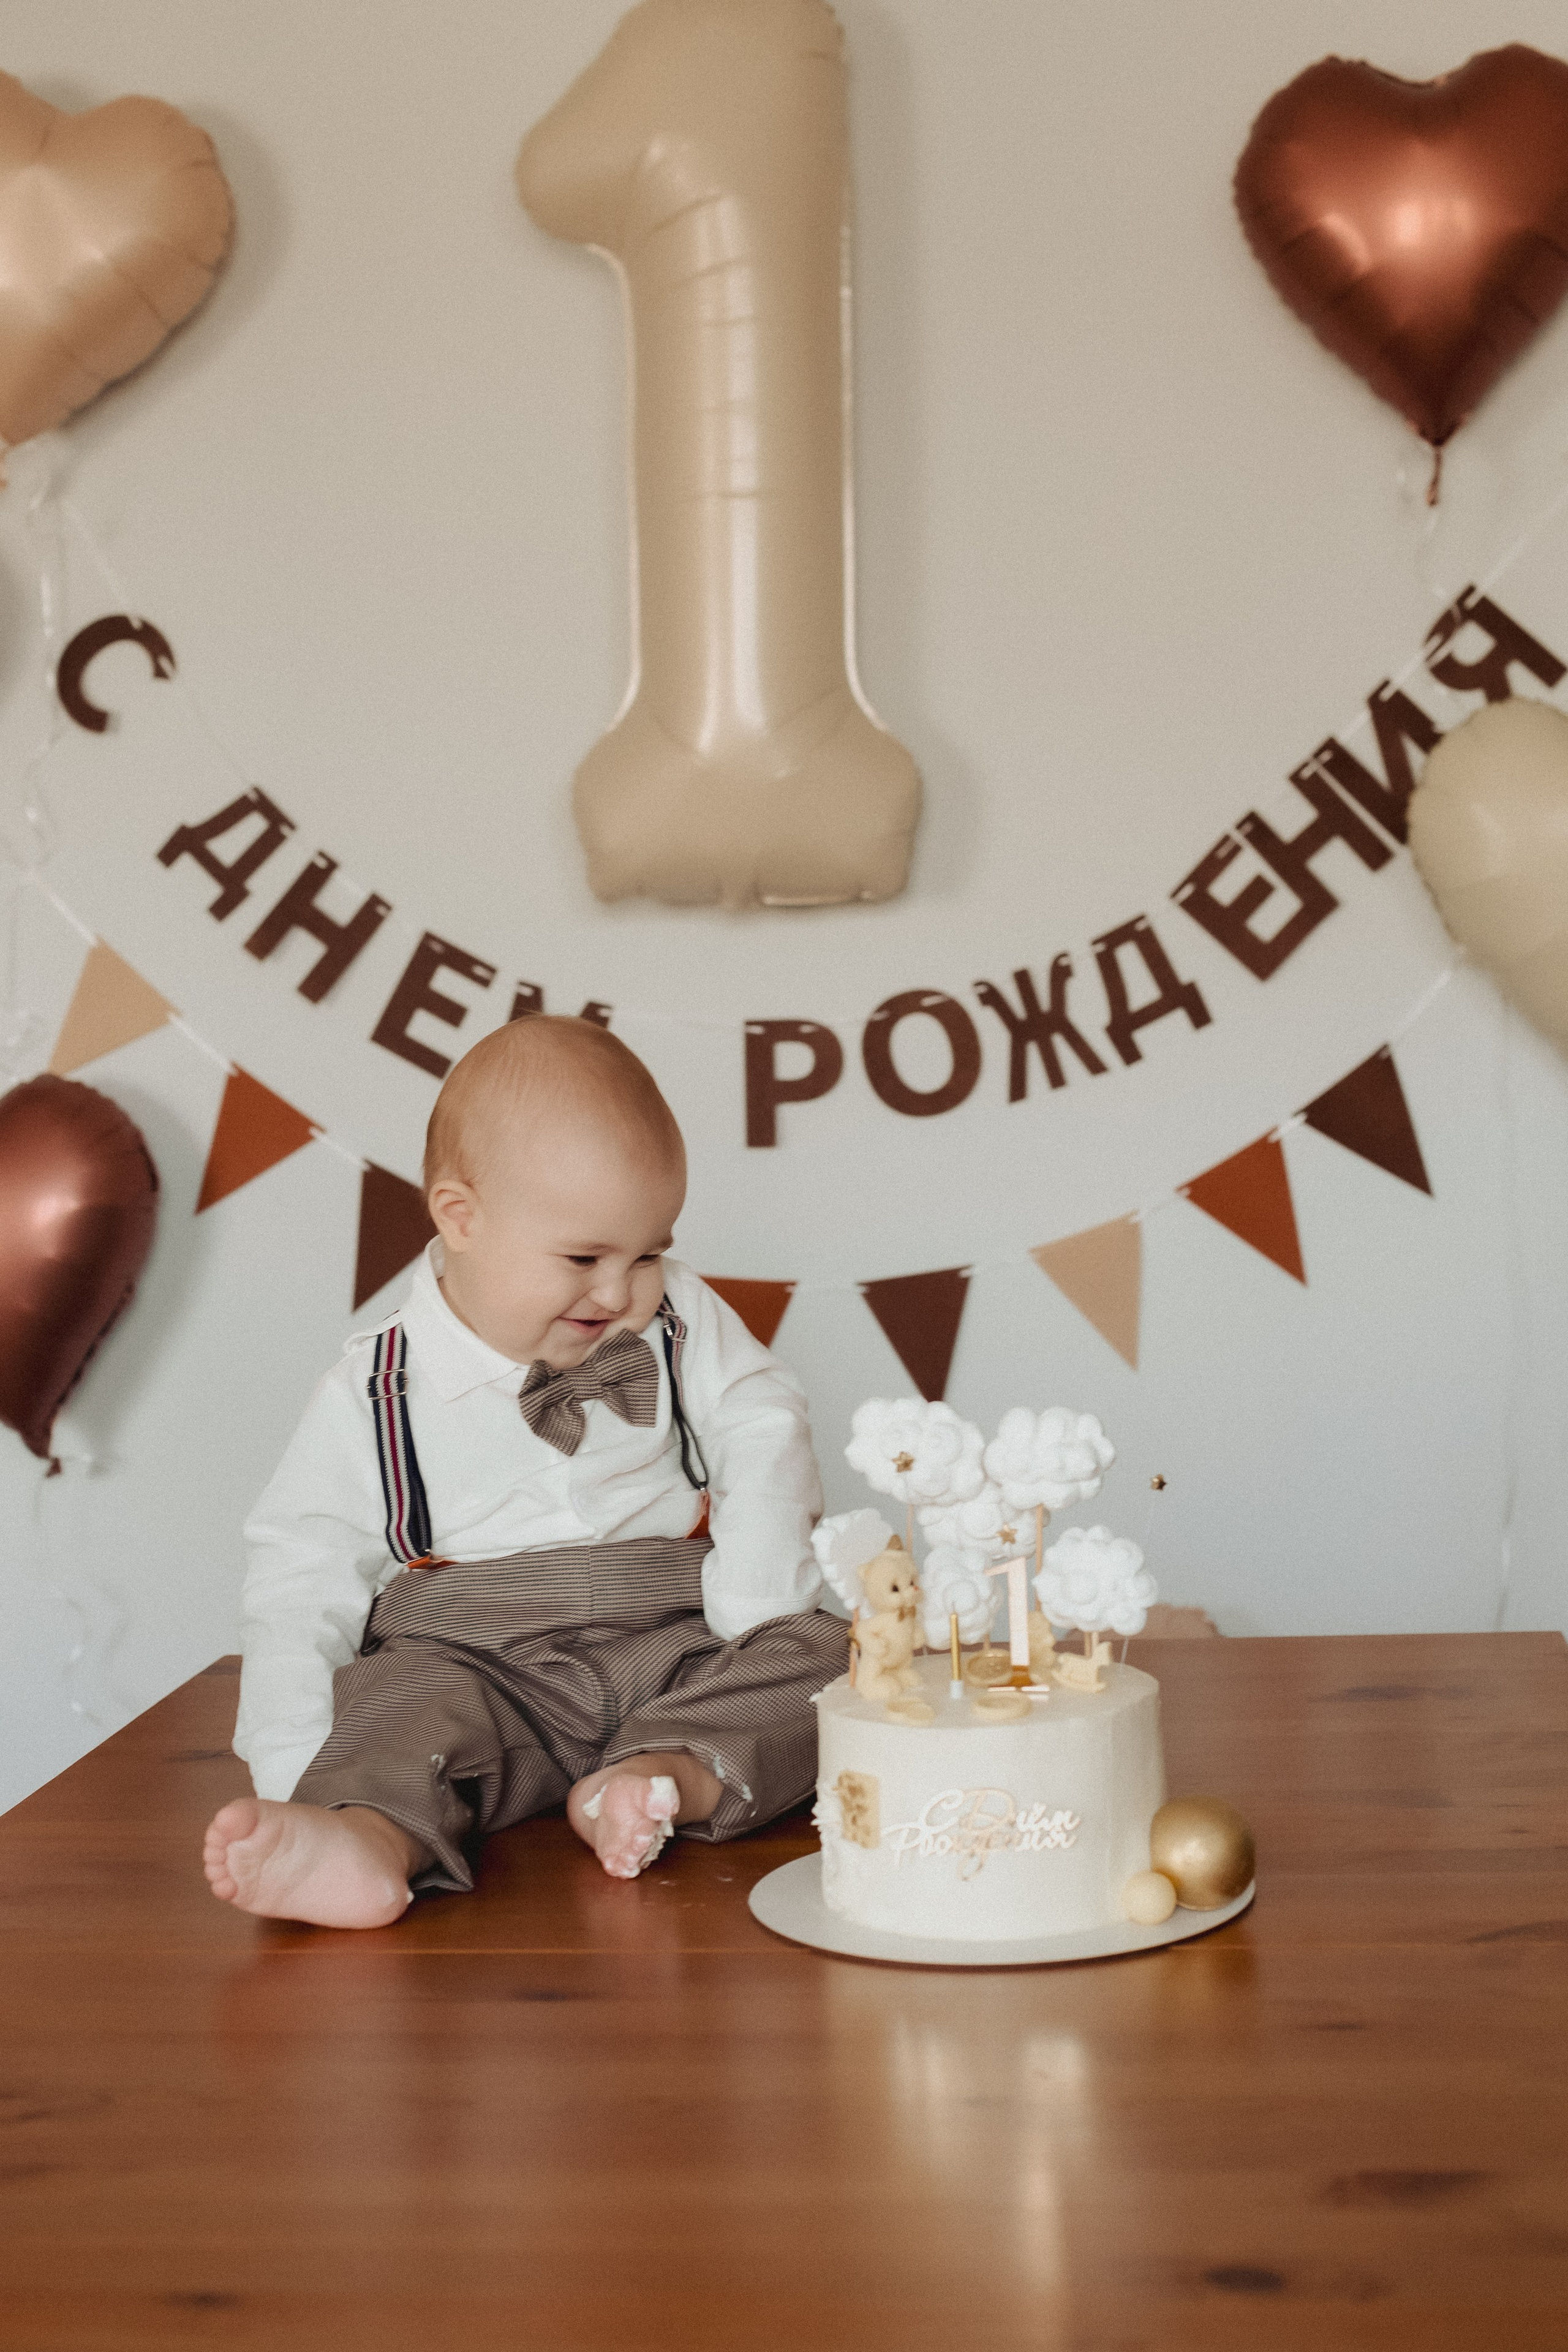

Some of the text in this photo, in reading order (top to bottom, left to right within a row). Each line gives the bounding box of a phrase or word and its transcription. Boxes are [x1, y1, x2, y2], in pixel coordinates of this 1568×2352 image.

[56, 584, 1568, 1148] С ДНЕ РОЖДЕНИЯ
